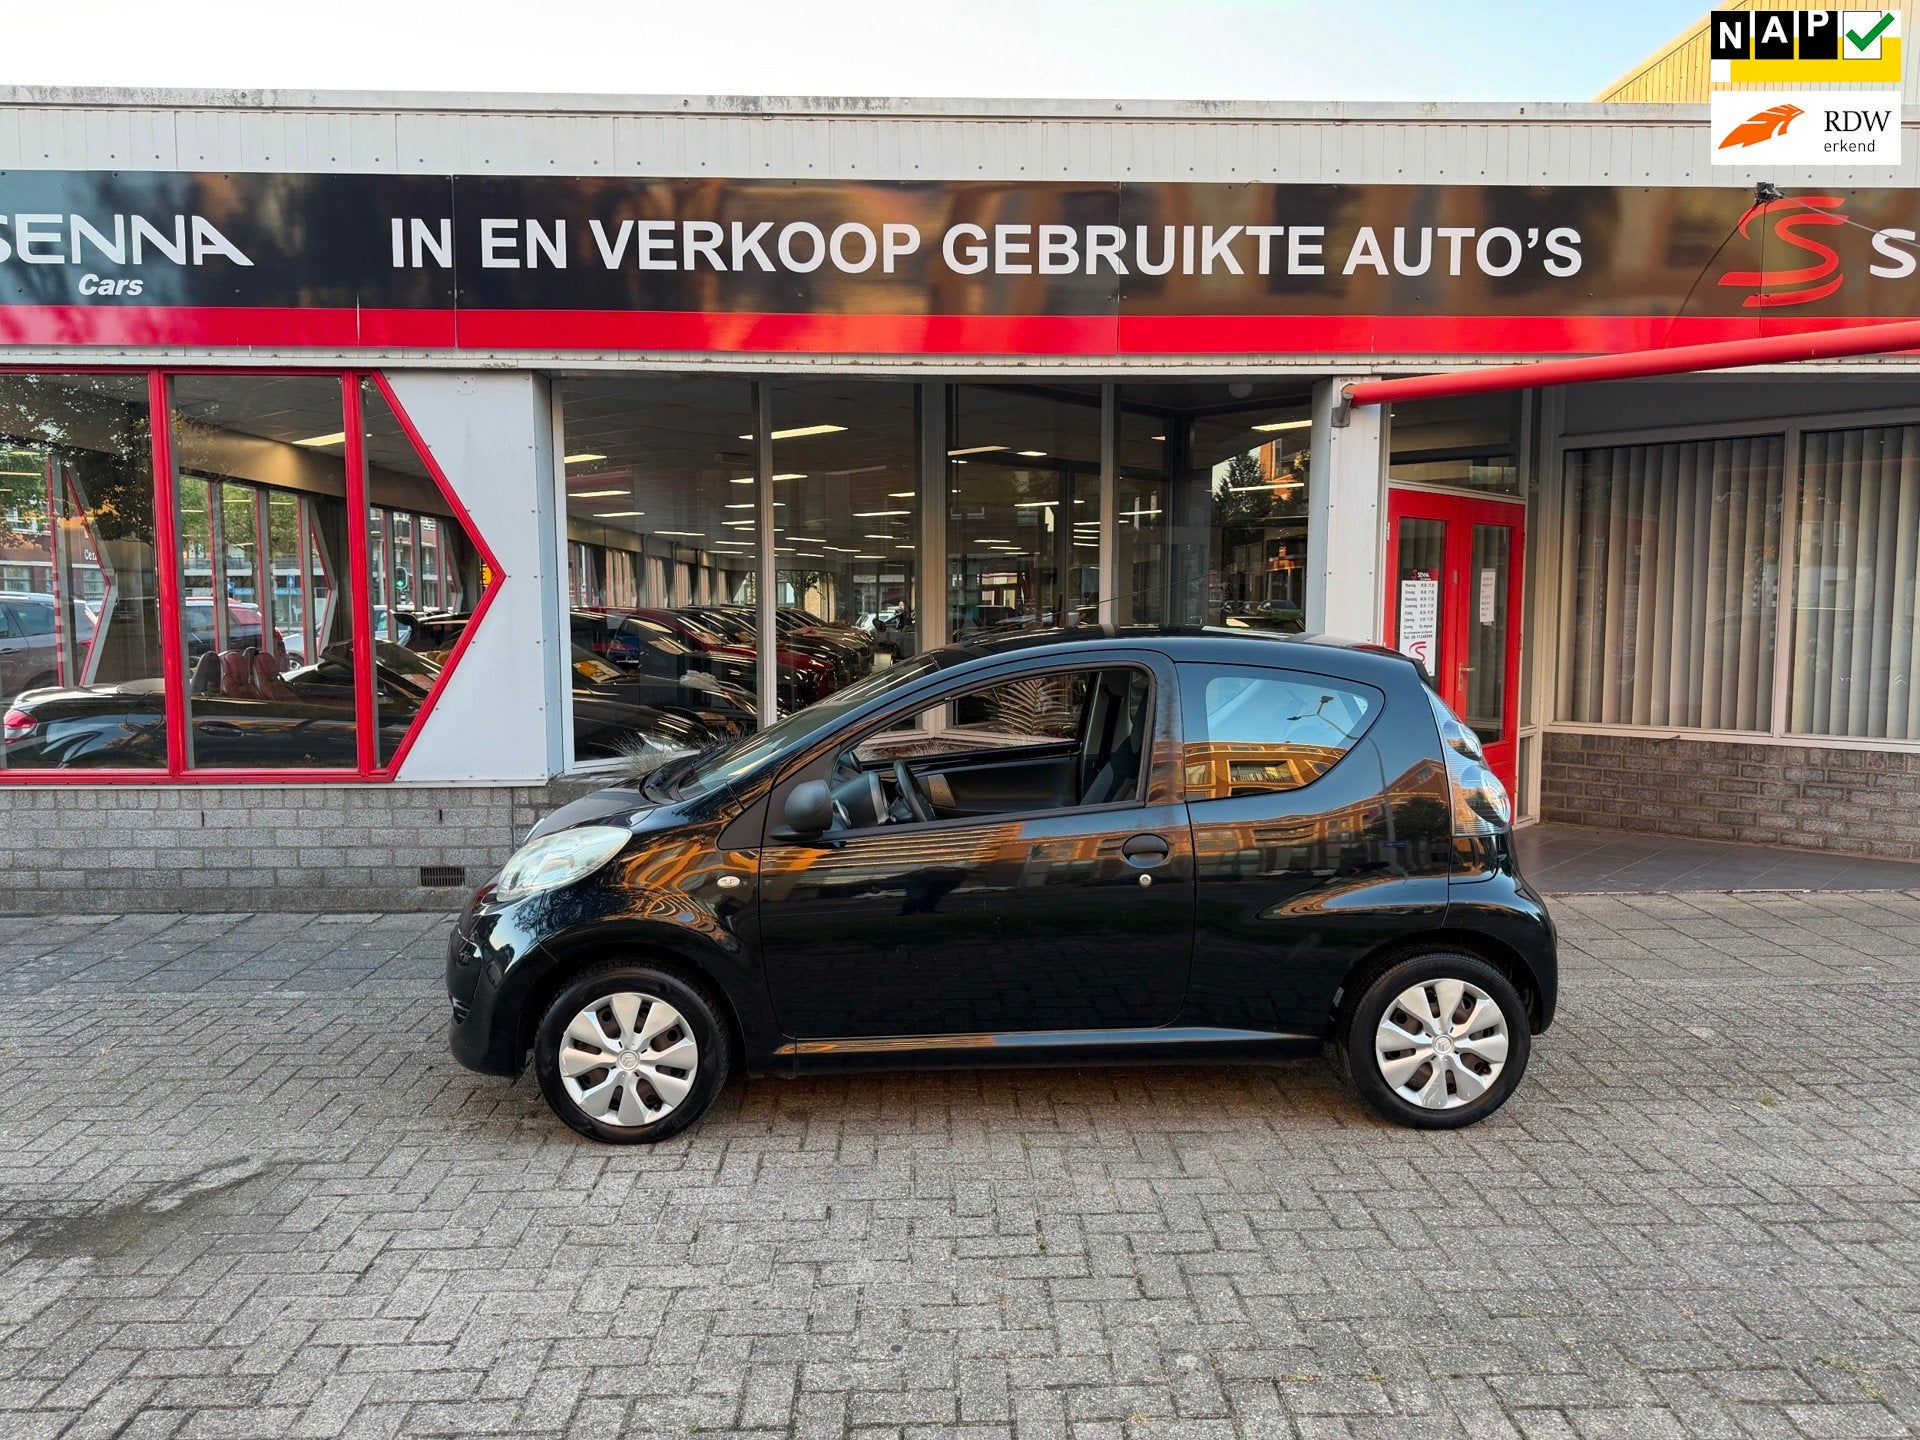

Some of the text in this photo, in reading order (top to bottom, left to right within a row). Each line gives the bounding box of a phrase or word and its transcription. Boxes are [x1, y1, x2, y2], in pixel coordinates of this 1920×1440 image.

[0, 213, 254, 266] ENNA
[391, 218, 1583, 278] IN EN VERKOOP GEBRUIKTE AUTO’S
[78, 273, 144, 296] Cars
